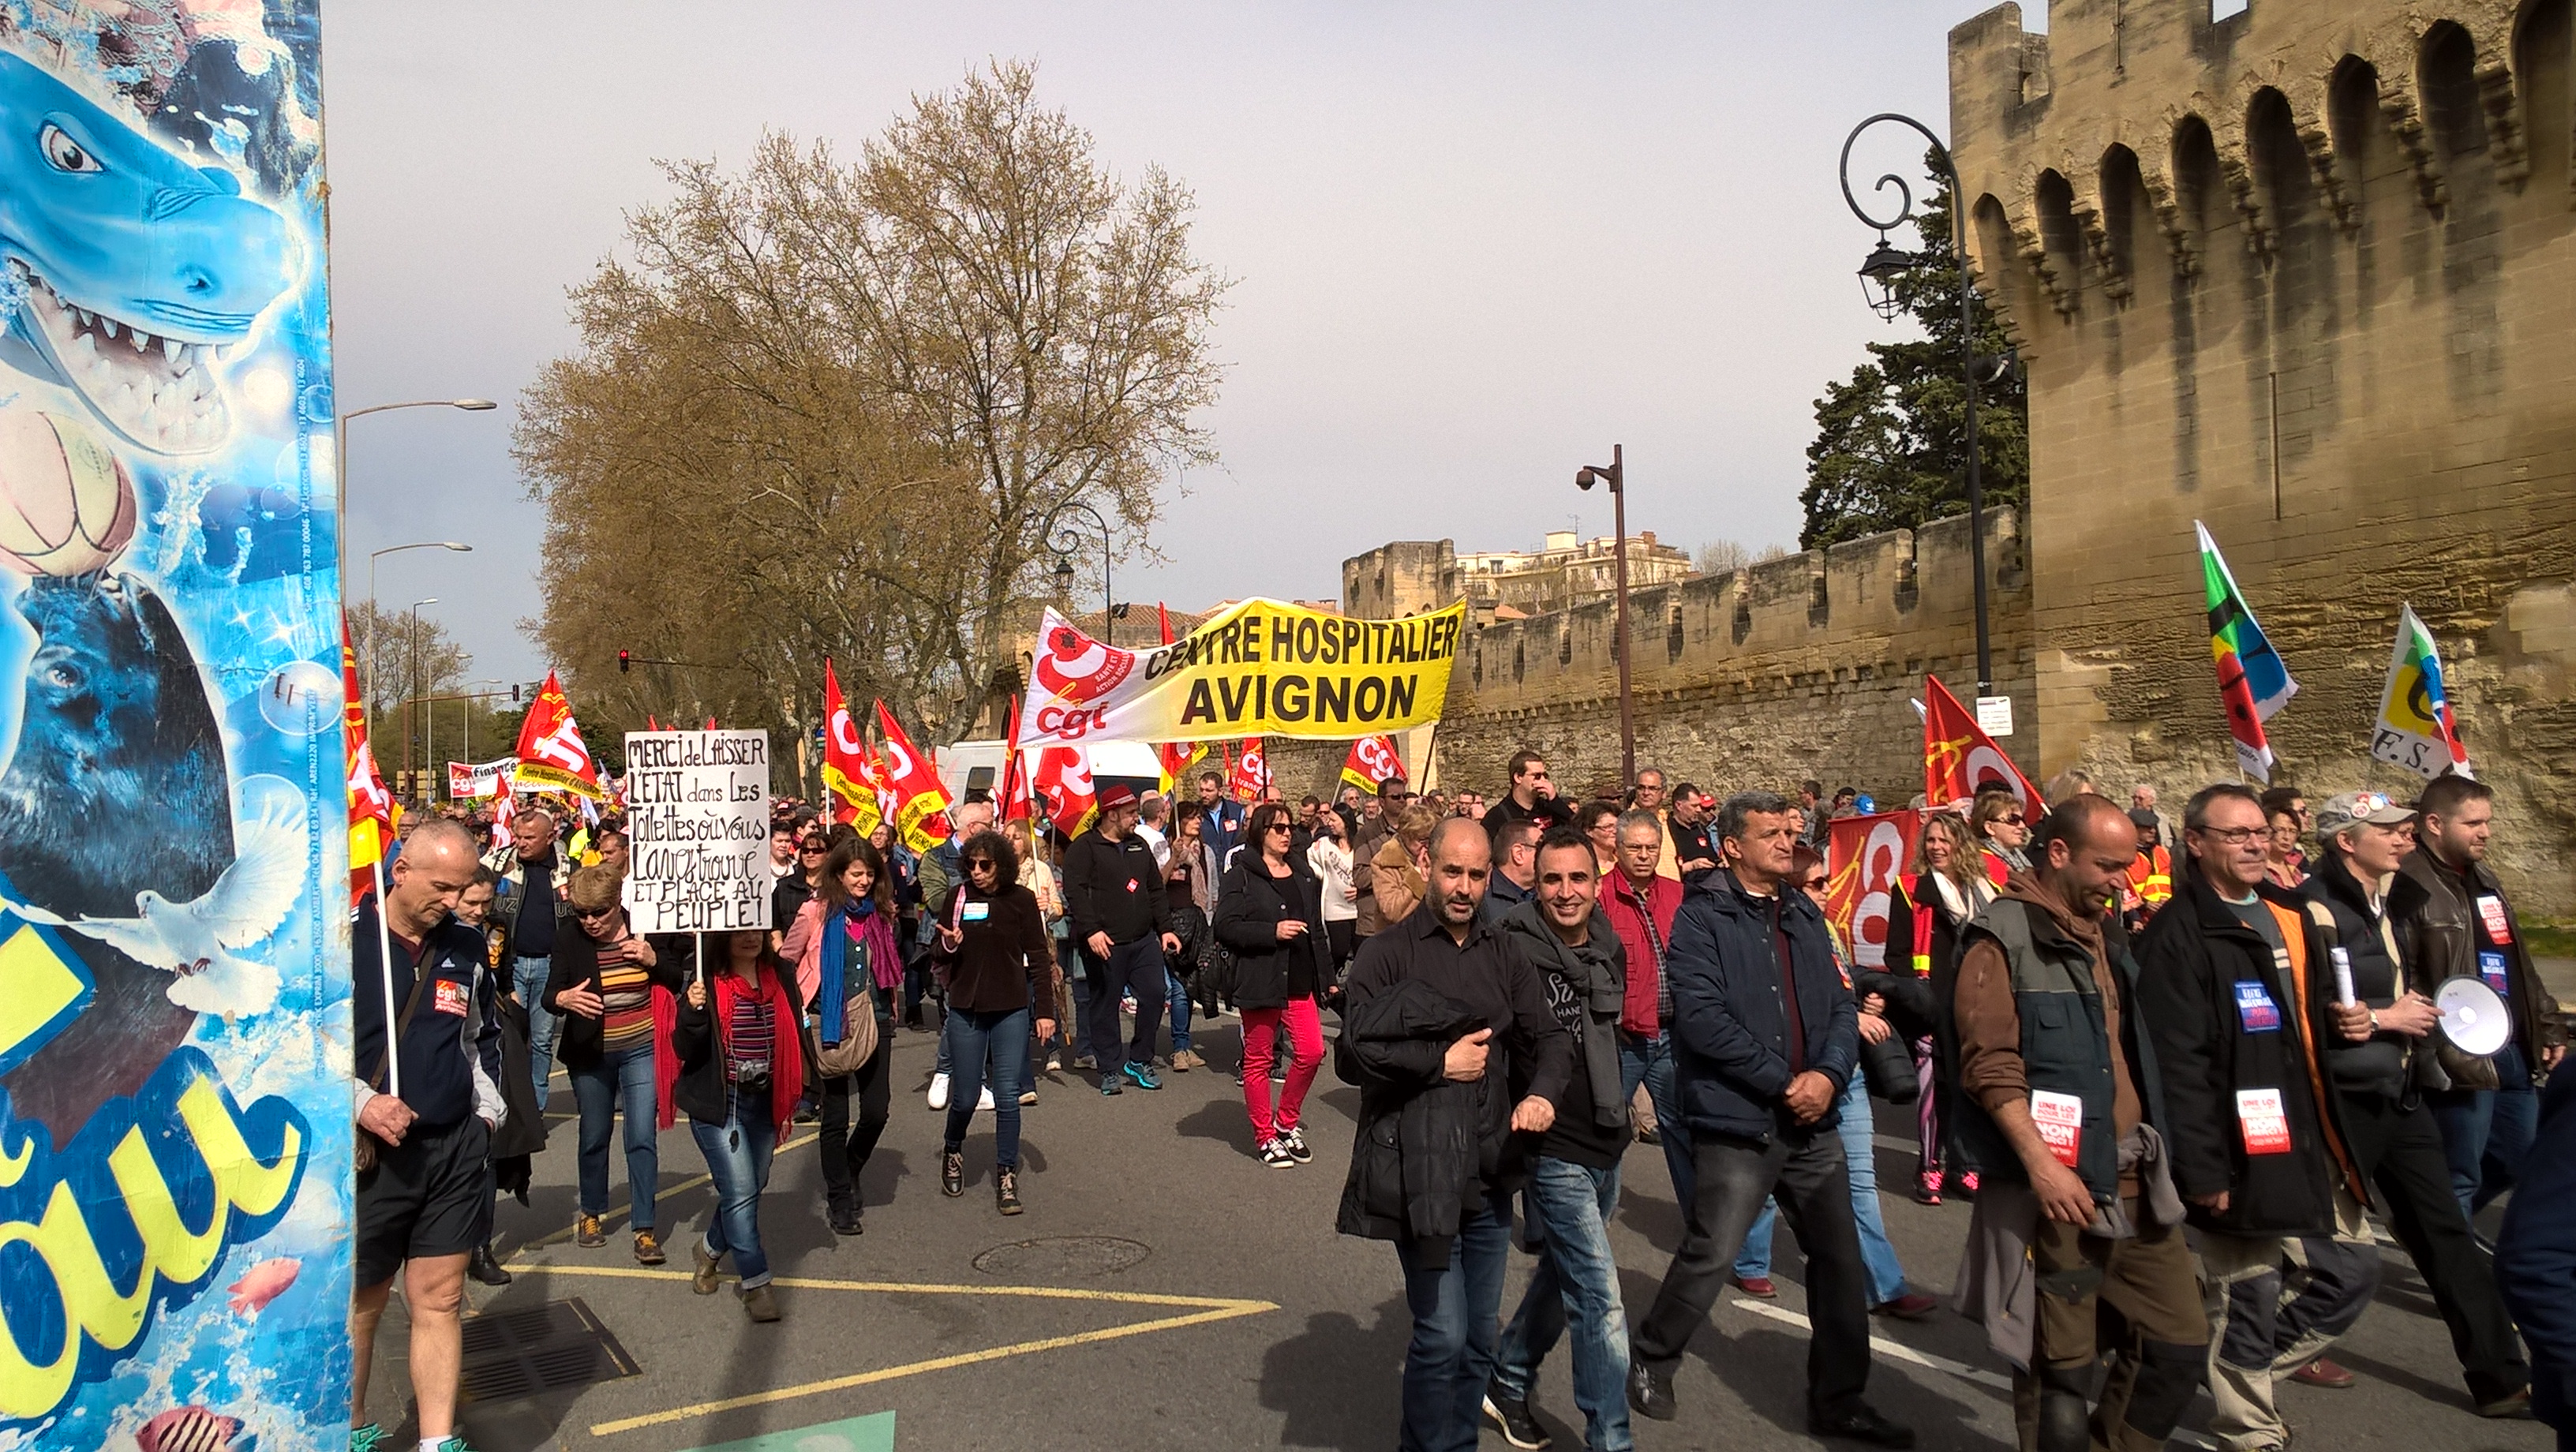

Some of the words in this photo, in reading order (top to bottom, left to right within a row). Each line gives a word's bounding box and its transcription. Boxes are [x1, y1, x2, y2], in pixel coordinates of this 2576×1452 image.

[1144, 616, 1261, 680] CENTRE
[1271, 614, 1458, 664] HOSPITALIER
[1095, 675, 1118, 694] ACTION
[1180, 675, 1418, 725] AVIGNON
[1036, 702, 1110, 739] cgt
[628, 734, 683, 768] MERCI
[684, 740, 701, 767] de
[687, 778, 723, 803] dans
[729, 772, 760, 802] Les
[628, 805, 695, 842] Toilettes
[697, 809, 721, 841] où
[635, 882, 657, 902] ET
[661, 881, 725, 903] PLACE
[732, 880, 763, 900] AU
[436, 989, 457, 1001] cgt
